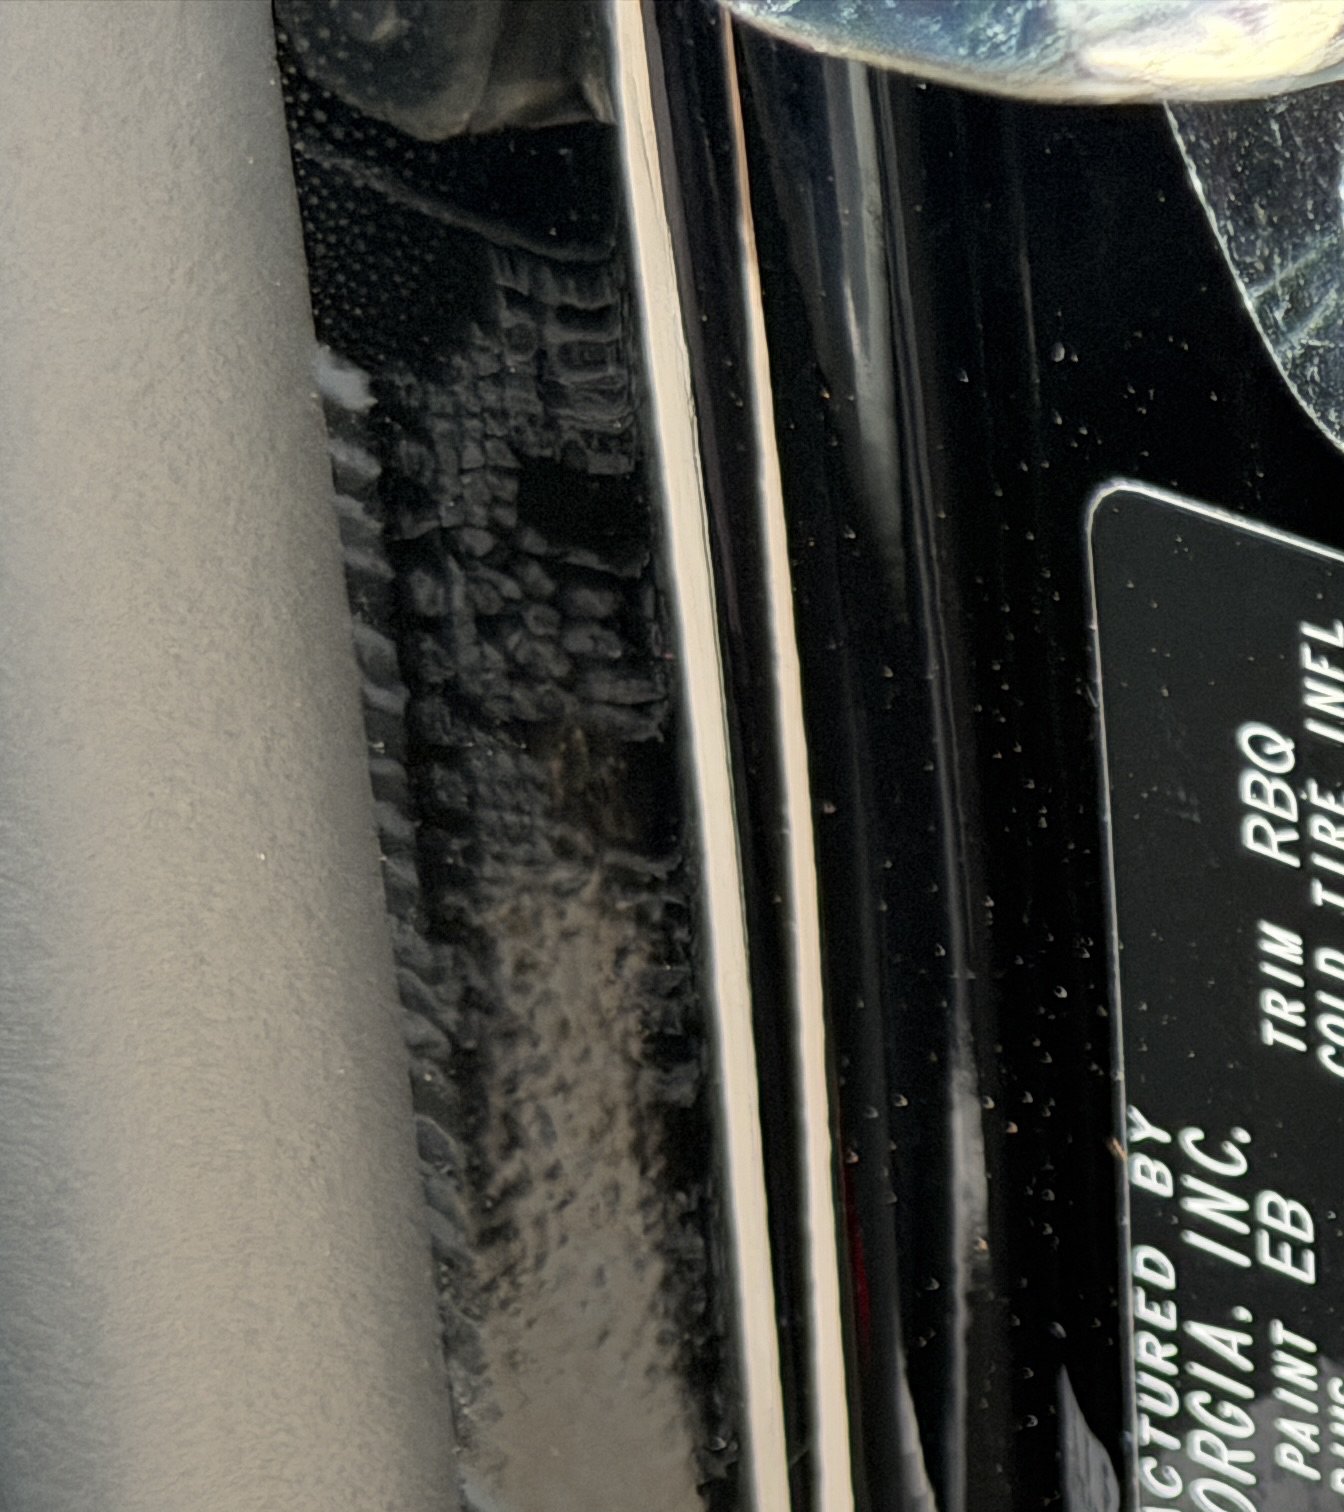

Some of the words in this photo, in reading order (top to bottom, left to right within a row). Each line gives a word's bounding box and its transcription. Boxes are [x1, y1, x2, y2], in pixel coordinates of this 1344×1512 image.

[1236, 722, 1302, 867] RBQ
[1257, 918, 1307, 1052] TRIM
[1127, 1105, 1175, 1197] BY
[1177, 1125, 1252, 1267] INC.
[1255, 1189, 1317, 1284] EB
[1271, 1319, 1321, 1481] PAINT
